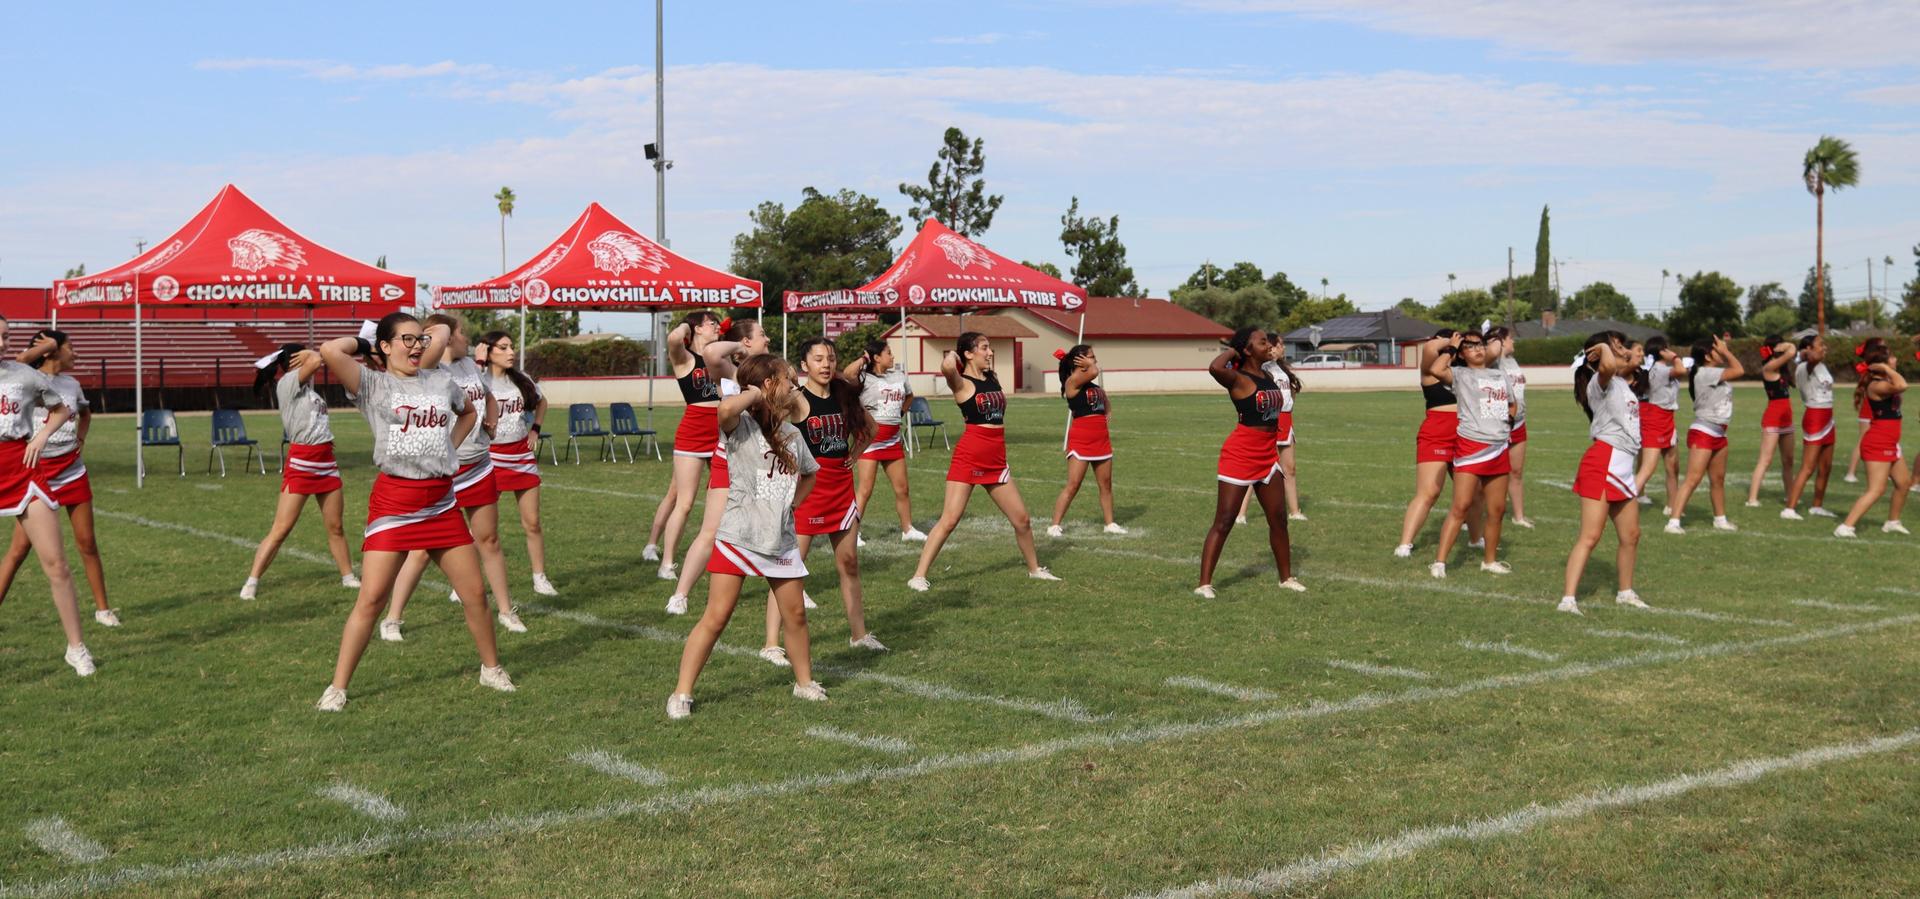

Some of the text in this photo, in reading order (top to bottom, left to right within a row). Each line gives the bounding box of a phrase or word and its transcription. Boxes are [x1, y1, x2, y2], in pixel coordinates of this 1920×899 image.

[278, 274, 296, 282] OF
[306, 275, 335, 283] THE
[186, 284, 371, 303] CHOWCHILLA TRIBE
[442, 287, 511, 306] CHOWCHILLA TRIBE
[551, 287, 730, 304] CHOWCHILLA TRIBE
[800, 290, 882, 308] CHOWCHILLA TRIBE
[930, 288, 1057, 306] CHOWCHILLA TRIBE
[1480, 386, 1509, 404] Trib
[395, 405, 448, 433] Tribe
[807, 516, 825, 525] TRIBE
[775, 558, 793, 567] TRIBE
